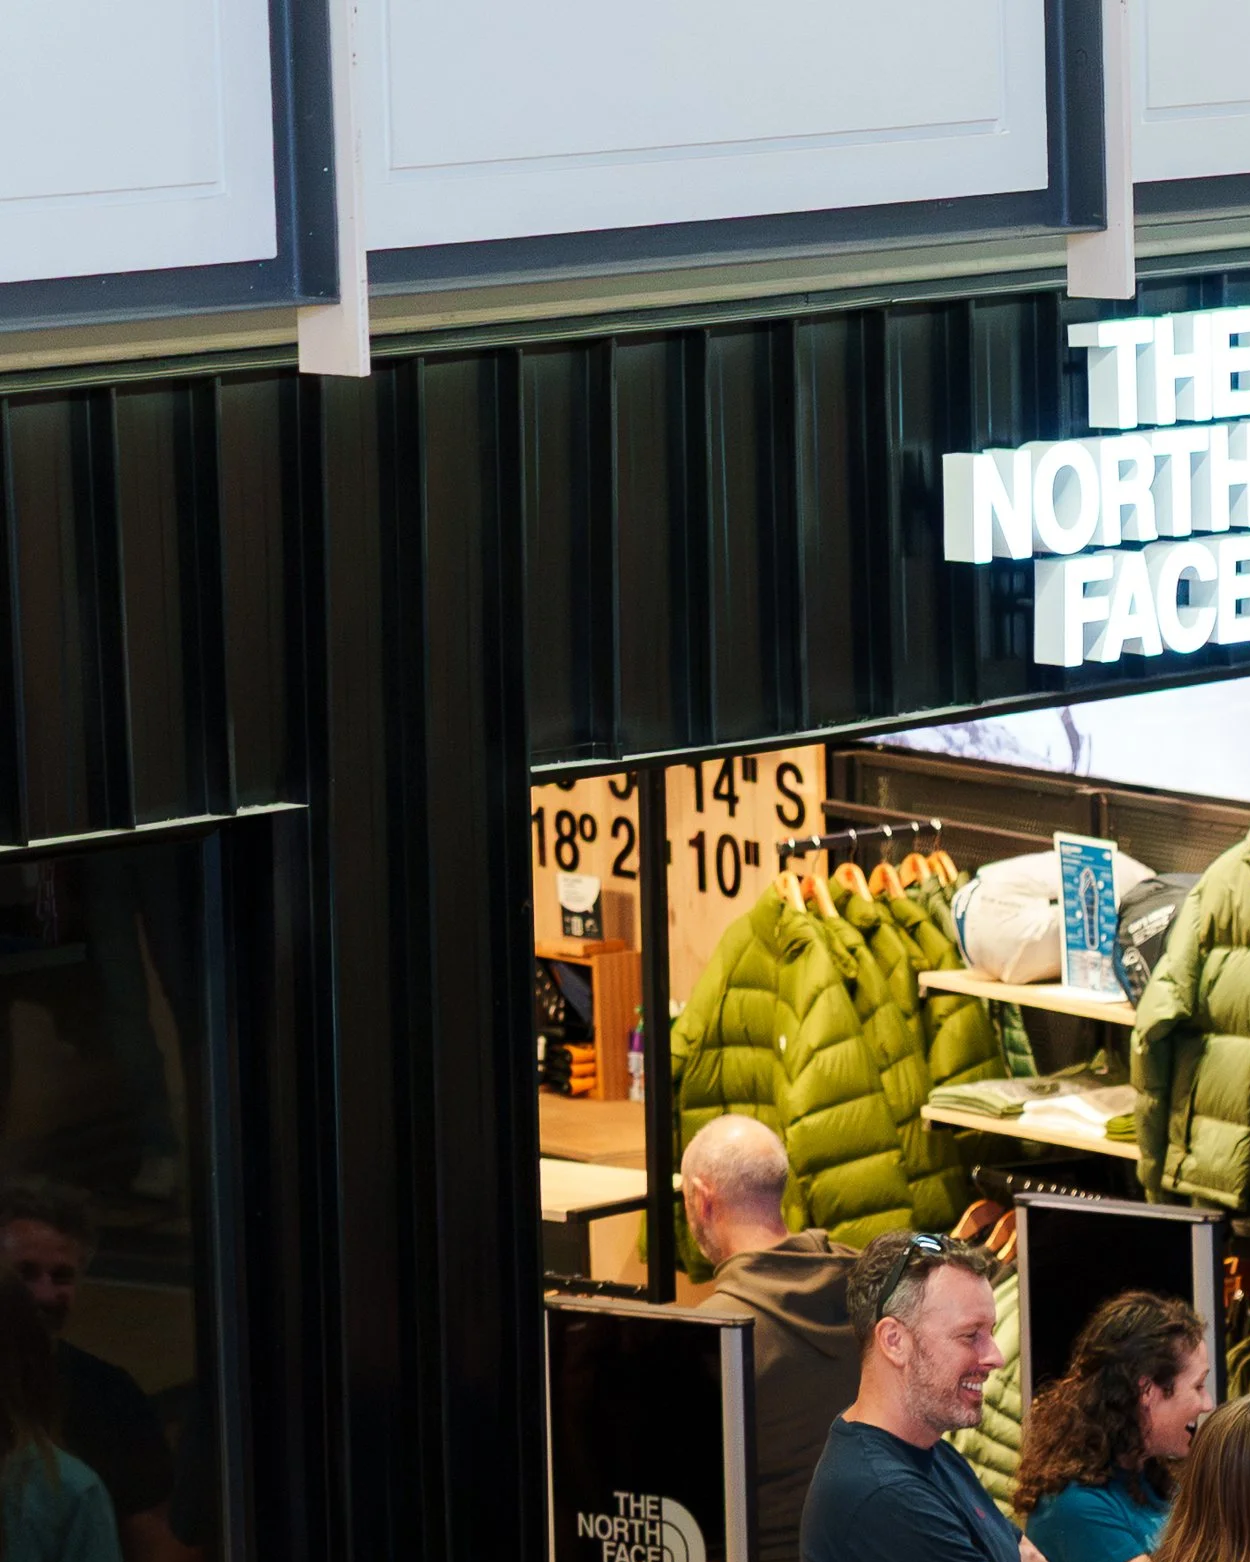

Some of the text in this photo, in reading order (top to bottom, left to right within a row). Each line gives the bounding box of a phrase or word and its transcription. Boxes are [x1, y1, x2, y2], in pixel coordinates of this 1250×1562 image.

[776, 762, 806, 829] S
[613, 1491, 660, 1520] THE
[577, 1511, 661, 1547] NORTH
